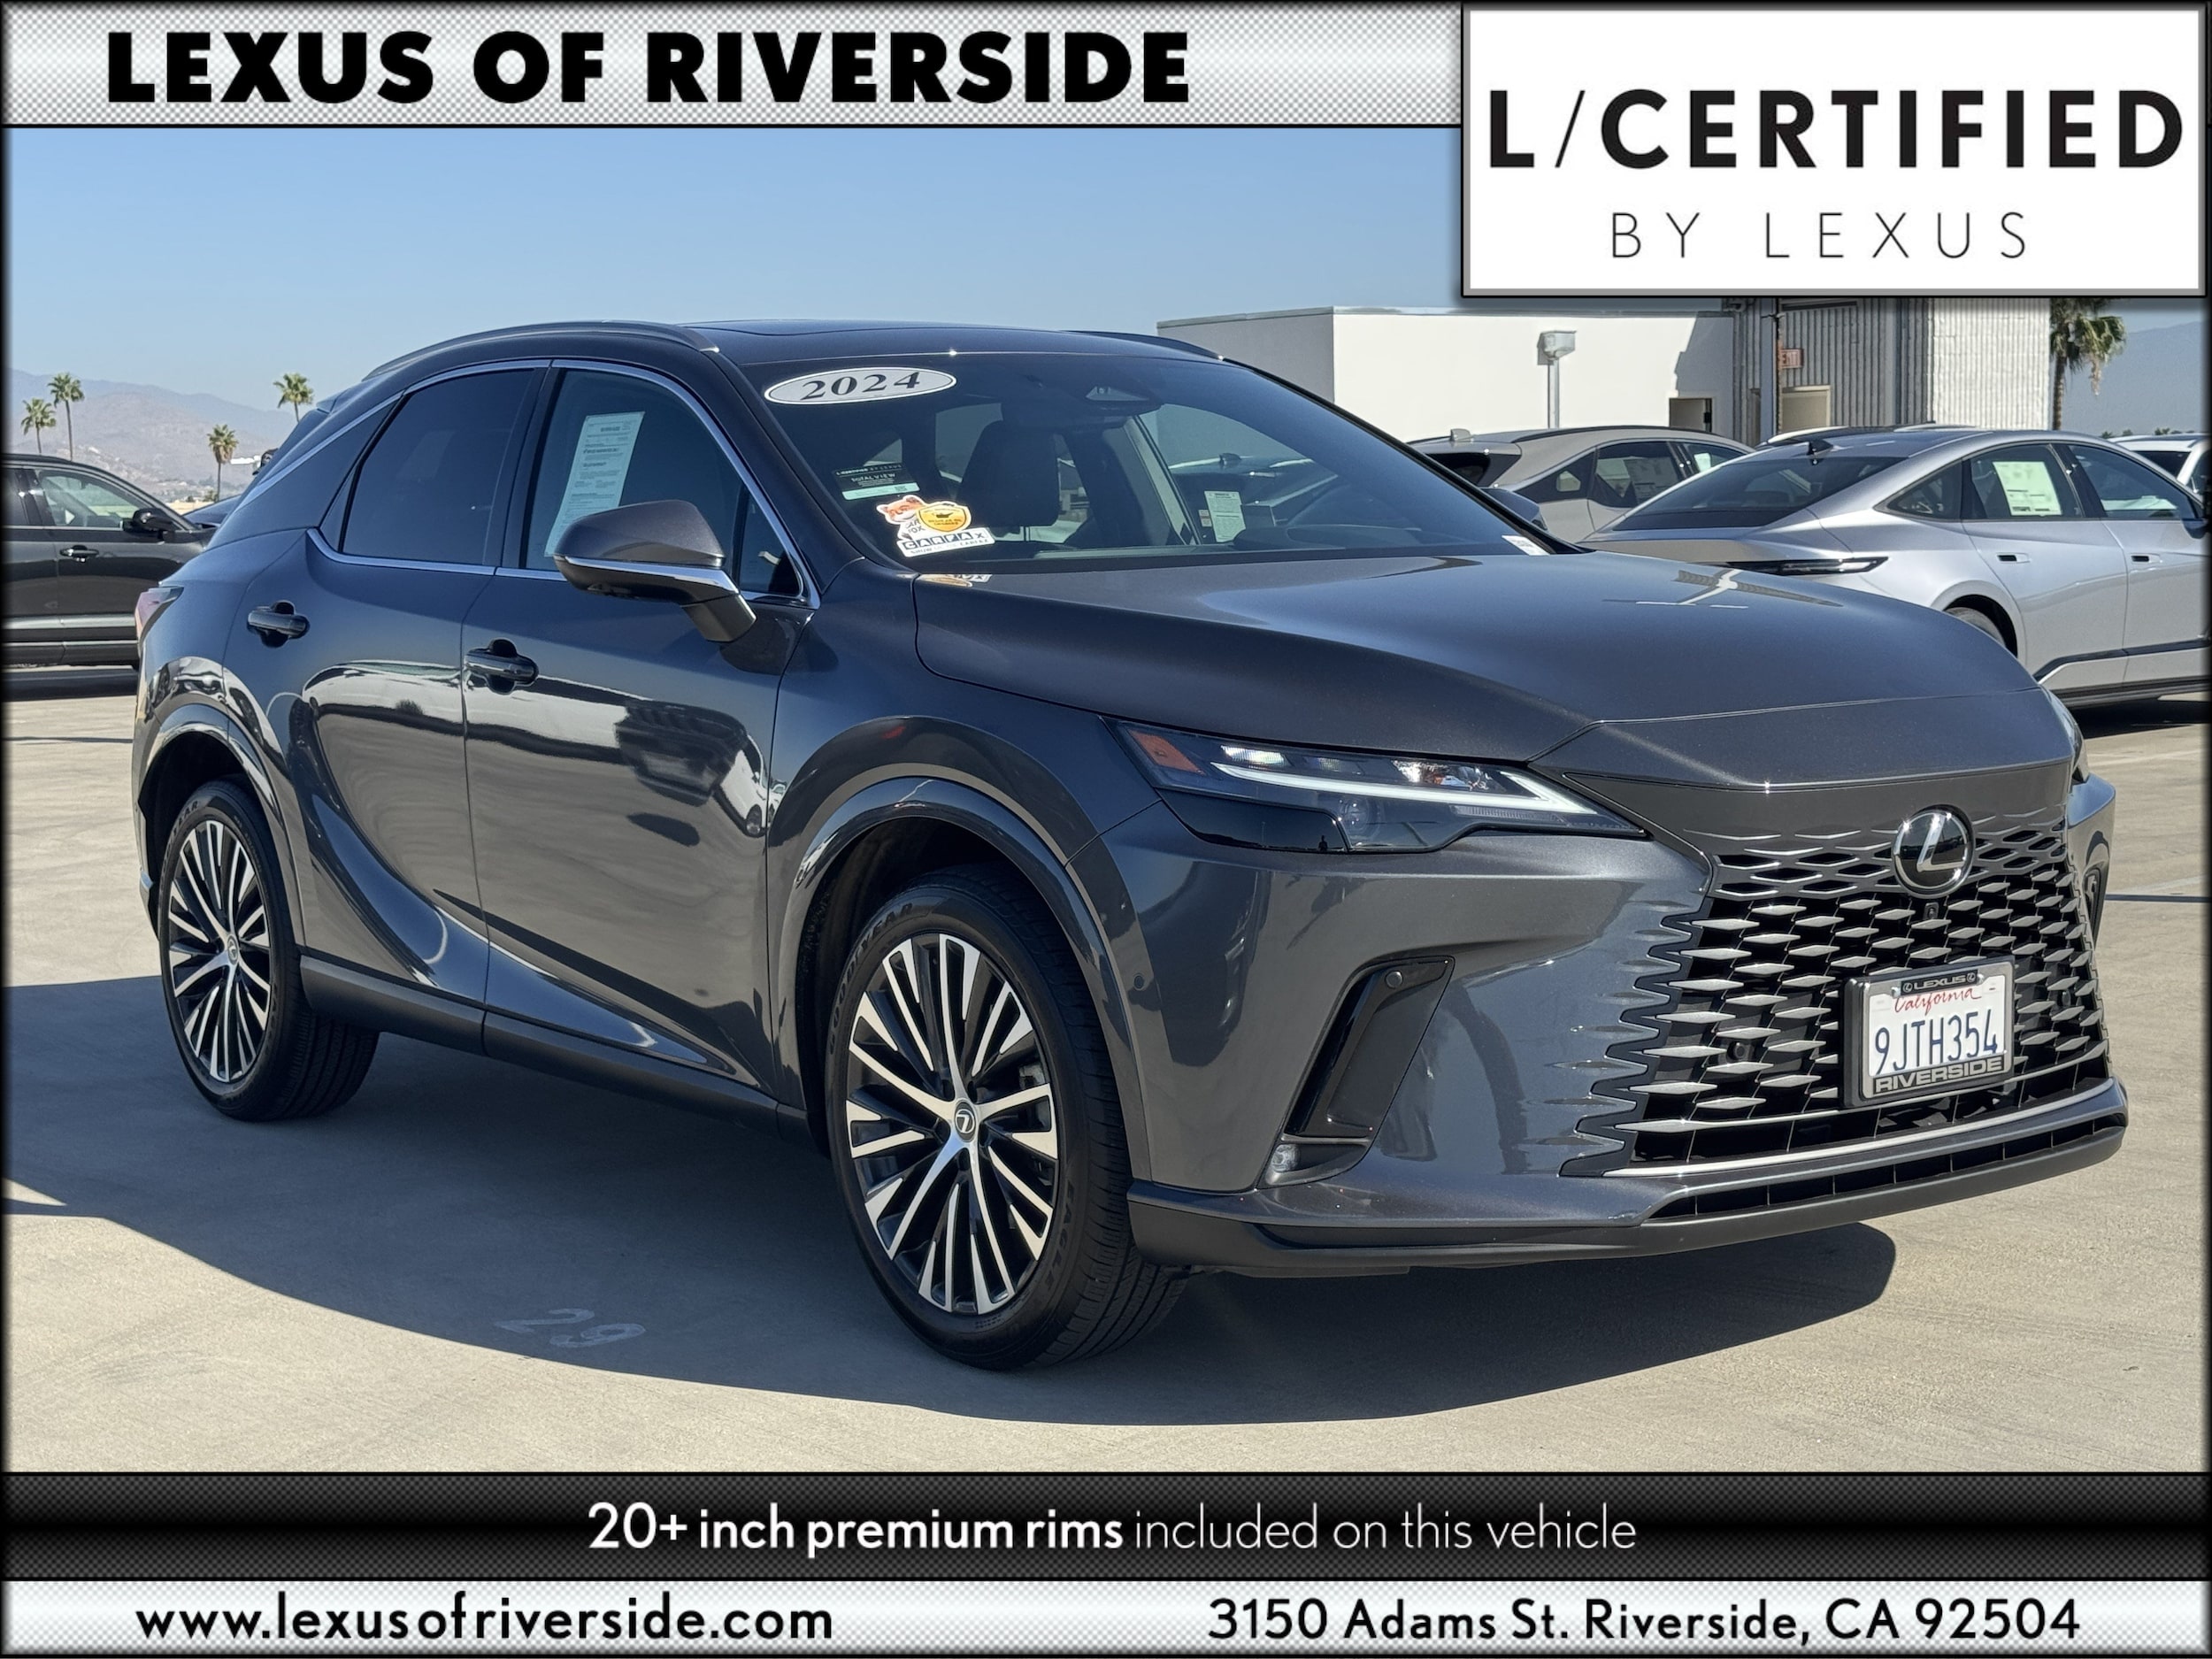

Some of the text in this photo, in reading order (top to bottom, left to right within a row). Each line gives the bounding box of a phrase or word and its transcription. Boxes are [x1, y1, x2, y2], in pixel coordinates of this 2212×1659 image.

[800, 372, 920, 401] 2024
[902, 531, 986, 549] CARFAX
[1914, 975, 1966, 990] LEXUS
[1893, 987, 1982, 1016] California
[1874, 1009, 1999, 1075] 9JTH354
[1875, 1056, 2002, 1094] RIVERSIDE
